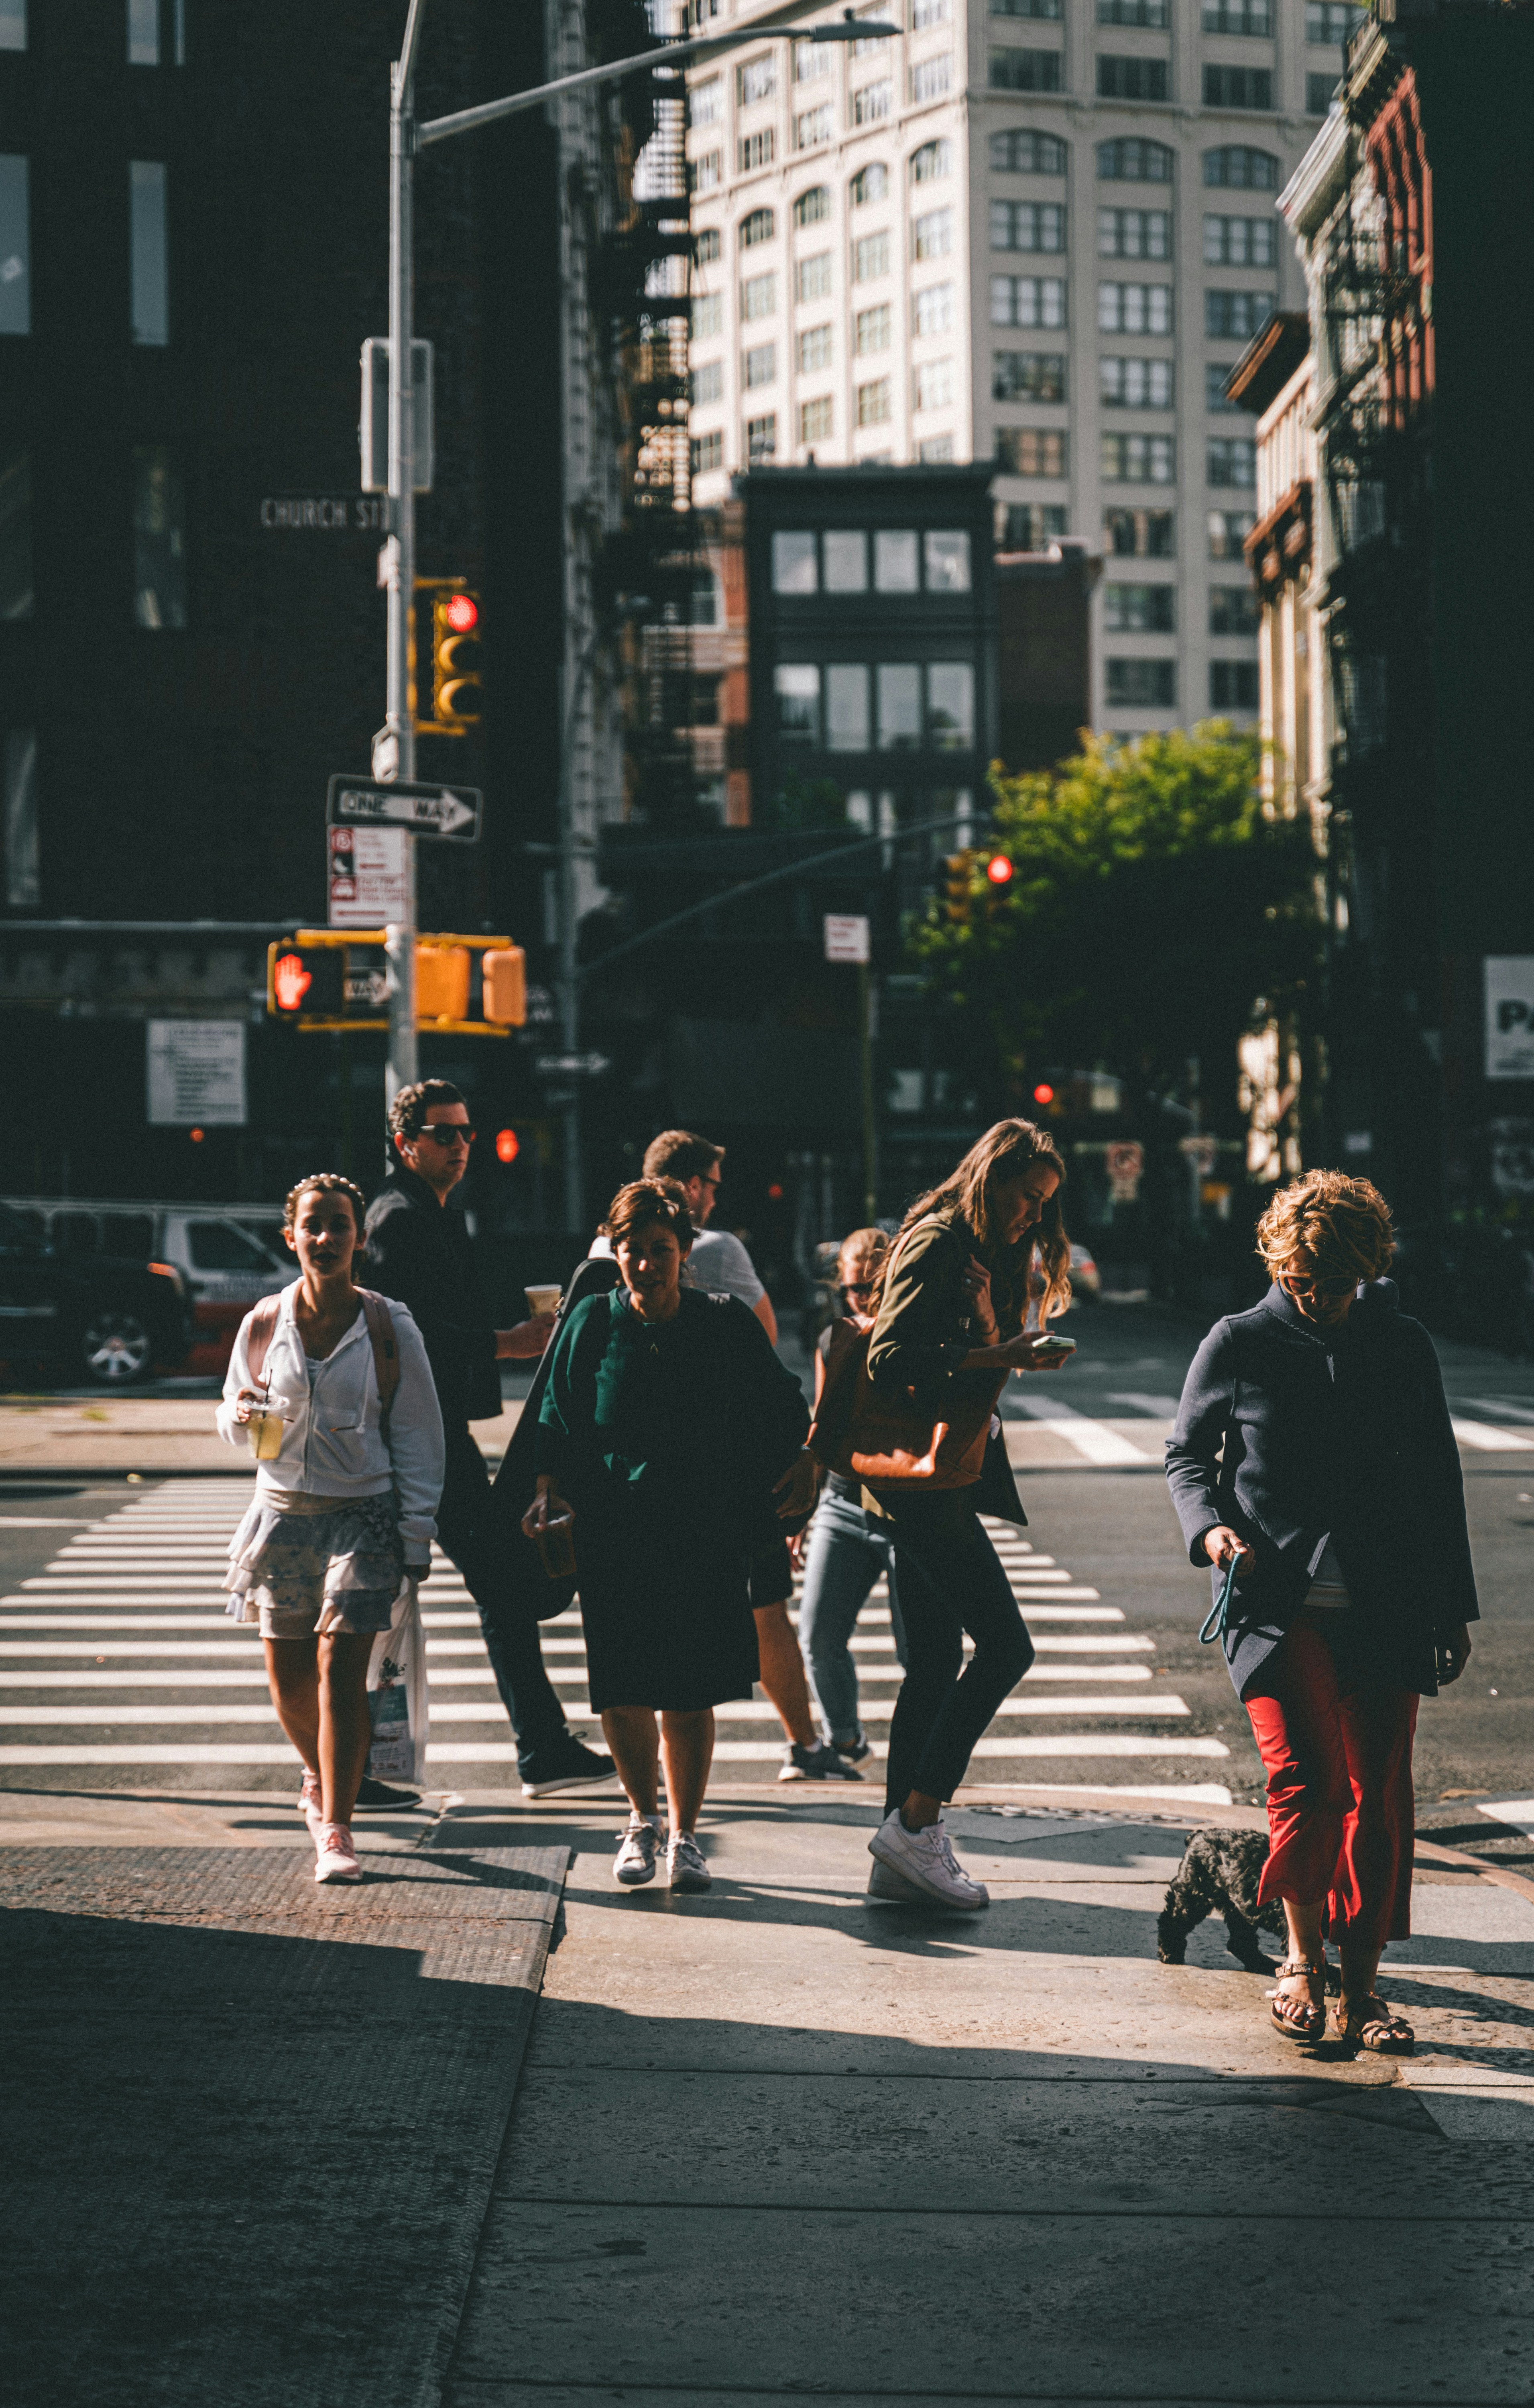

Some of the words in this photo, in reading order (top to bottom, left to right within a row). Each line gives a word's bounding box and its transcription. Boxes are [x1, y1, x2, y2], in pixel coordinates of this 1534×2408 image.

[260, 498, 346, 528] CHURCH
[343, 793, 386, 814] ONE
[413, 799, 456, 820] WAY
[352, 981, 381, 995] WAY
